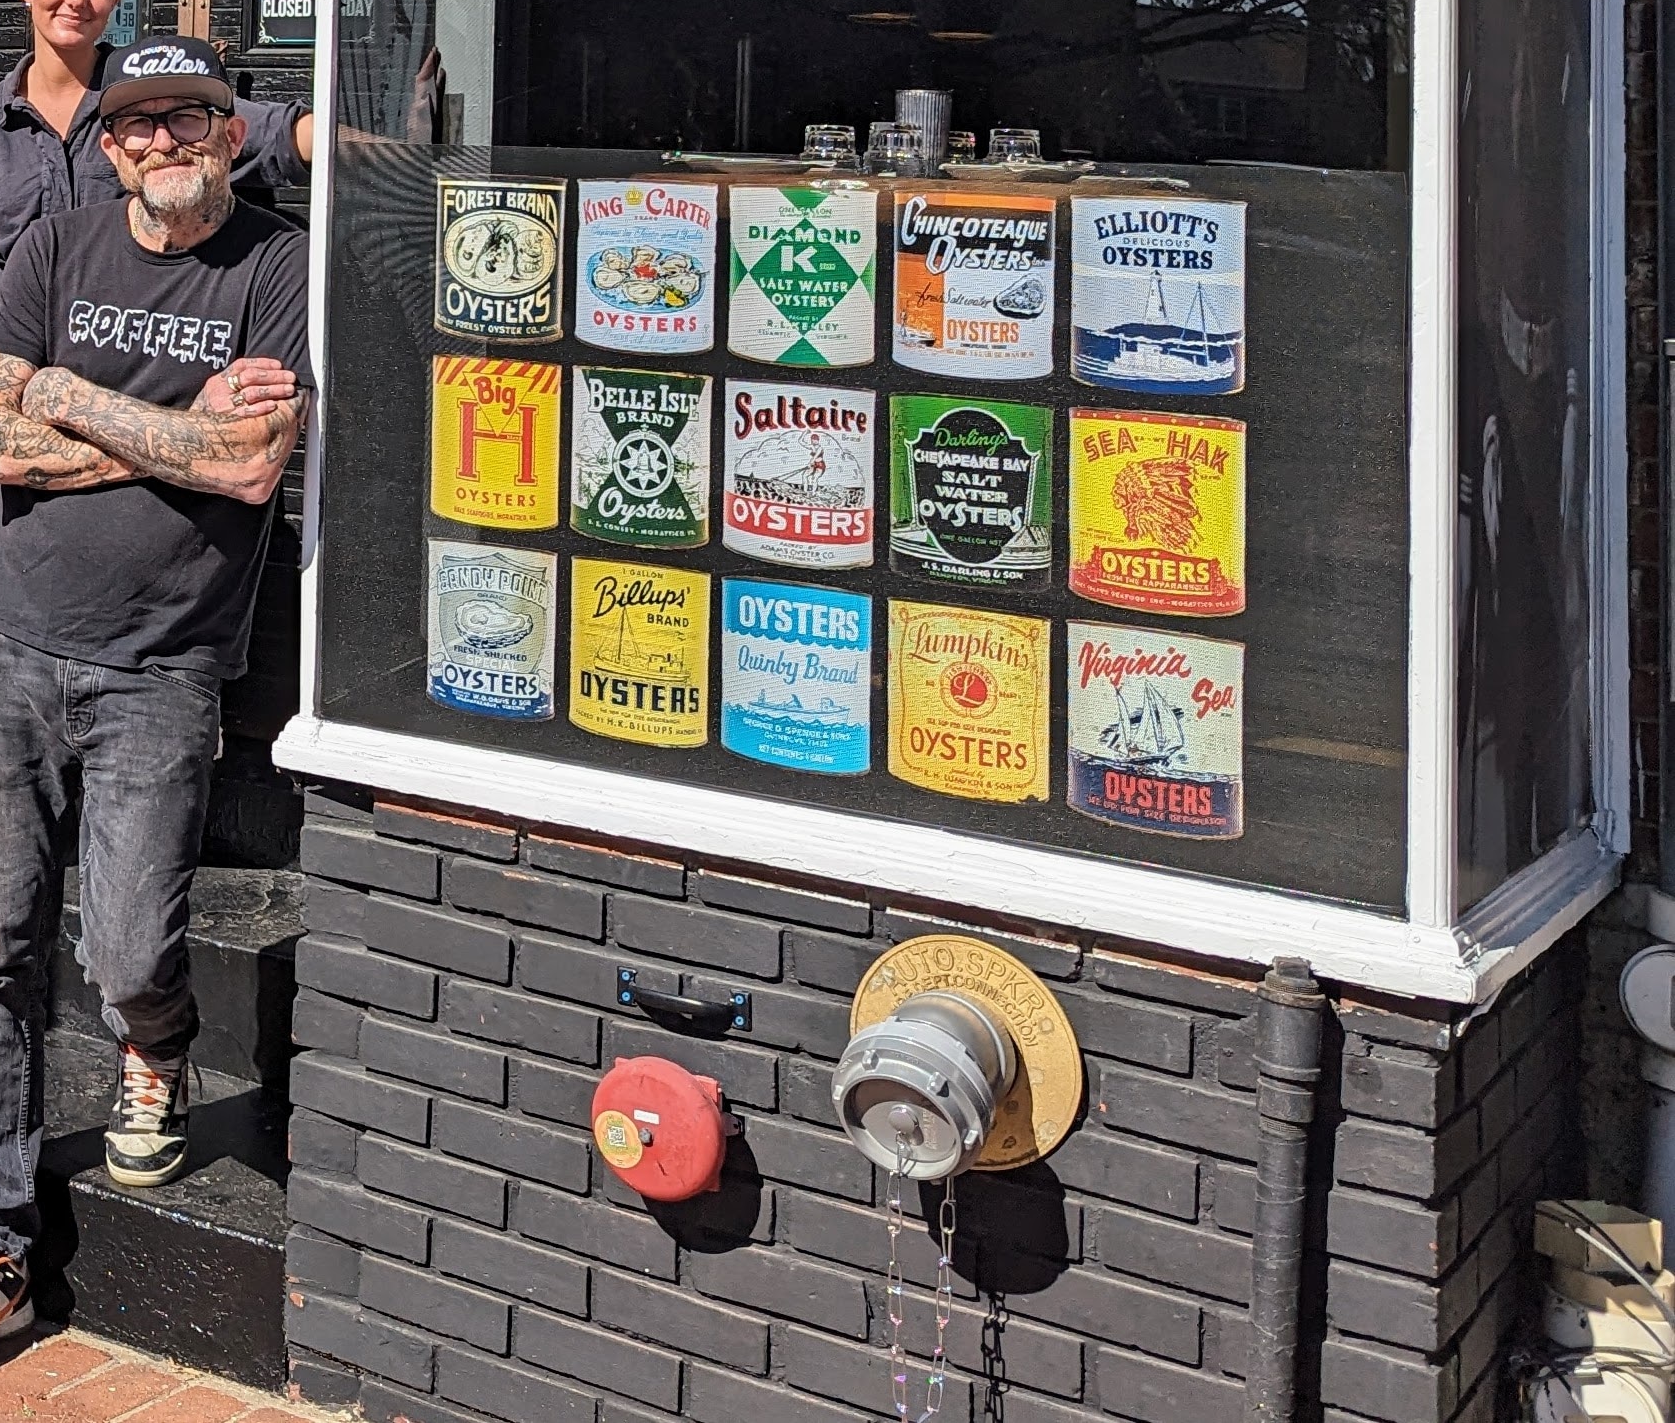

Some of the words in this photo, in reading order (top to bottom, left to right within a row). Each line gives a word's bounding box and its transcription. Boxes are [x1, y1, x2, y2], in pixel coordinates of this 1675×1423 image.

[122, 48, 209, 77] Sailor
[444, 189, 503, 231] FOREST
[506, 192, 559, 239] BRAND
[583, 197, 624, 226] KING
[645, 188, 712, 230] CARTER
[901, 195, 1048, 248] CHINCOTEAGUE
[748, 226, 861, 244] DIAMOND
[1094, 210, 1220, 243] ELLIOTT'S
[1123, 236, 1191, 248] DELICIOUS
[780, 245, 818, 273] K
[925, 235, 1033, 275] OYSTERS
[1102, 246, 1214, 270] OYSTERS
[759, 277, 793, 291] SALT
[798, 280, 848, 293] WATER
[771, 293, 835, 307] OYSTERS
[446, 282, 551, 324] OYSTERS
[68, 301, 233, 370] COFFEE
[487, 325, 522, 335] OYSTER
[593, 310, 698, 333] OYSTERS
[946, 318, 1020, 344] OYSTERS
[473, 377, 517, 415] Big
[588, 378, 658, 414] BELLE
[659, 383, 700, 422] ISLE
[616, 411, 675, 428] BRAND
[734, 391, 868, 440] Saltaire
[456, 398, 539, 487] H
[934, 427, 1010, 456] Darling's
[1083, 428, 1138, 462] SEA
[1165, 430, 1230, 475] HAK
[914, 448, 998, 471] CHESAPEAKE
[1003, 458, 1031, 472] BAY
[934, 484, 1009, 504] WATER
[941, 470, 1003, 488] SALT
[456, 487, 537, 507] OYSTERS
[598, 486, 688, 525] Oysters
[732, 498, 866, 537] OYSTERS
[918, 498, 1024, 531] OYSTERS
[789, 549, 820, 558] OYSTER
[1101, 551, 1211, 584] OYSTERS
[437, 567, 496, 595] SANDY
[498, 572, 548, 610] POINT
[630, 569, 664, 579] GALLON
[942, 565, 991, 577] DARLING
[1003, 571, 1025, 580] SON
[592, 576, 691, 618] Billups'
[647, 613, 690, 628] BRAND
[739, 595, 860, 642] OYSTERS
[453, 645, 480, 655] FRESH
[485, 650, 528, 662] SHUCKED
[907, 621, 1031, 671] Lumpkin's
[444, 664, 538, 696] OYSTERS
[737, 645, 799, 686] Quinby
[803, 652, 860, 685] Brand
[1078, 641, 1192, 689] Virginia
[1191, 677, 1236, 720] Sea
[580, 669, 700, 713] OYSTERS
[953, 673, 984, 706] L
[909, 726, 1028, 770] OYSTERS
[1104, 771, 1213, 816] OYSTERS
[952, 975, 1038, 1048] CONNECTION
